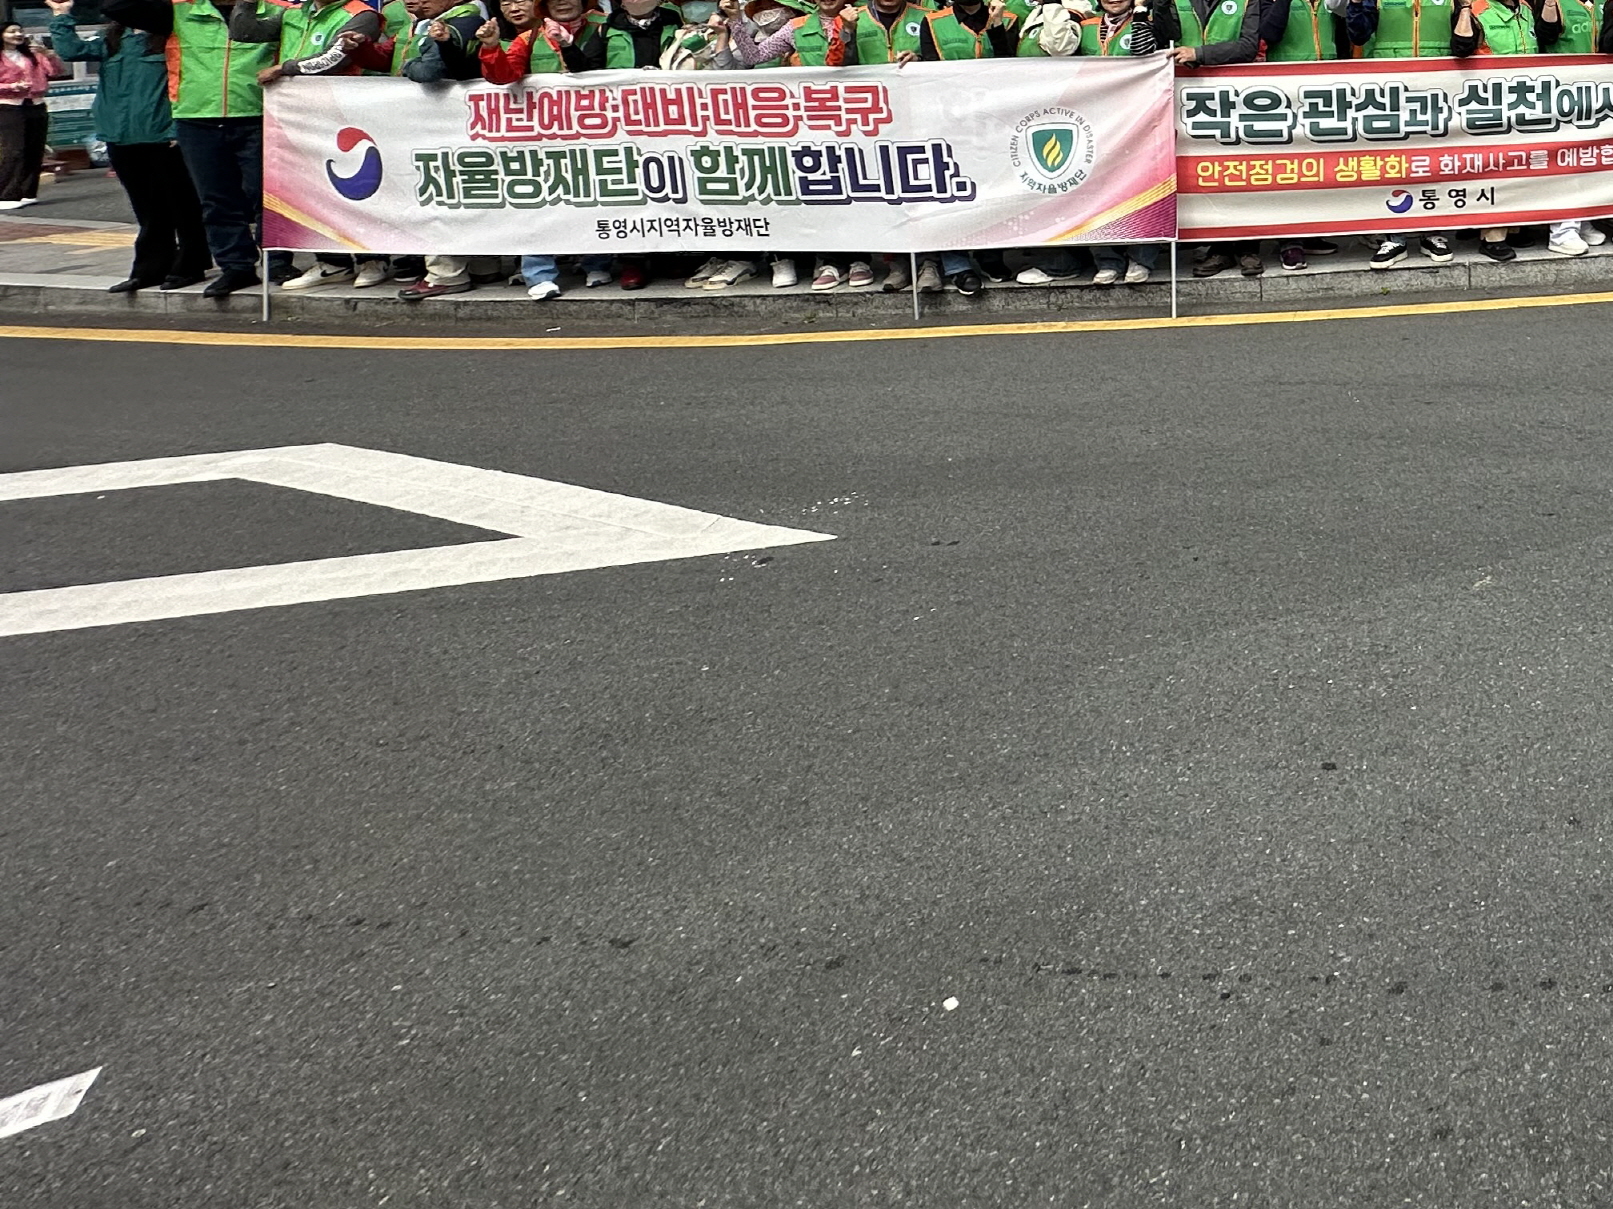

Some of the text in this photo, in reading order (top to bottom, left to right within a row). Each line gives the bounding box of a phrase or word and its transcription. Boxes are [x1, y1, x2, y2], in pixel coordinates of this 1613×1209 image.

[1182, 86, 1295, 144] 작은
[1298, 82, 1451, 140] 관심과
[1010, 135, 1021, 167] CITIZEN
[1016, 108, 1095, 165] CORPS ACTIVE IN DISASTER
[412, 144, 688, 208] 자율방재단이
[1020, 169, 1087, 194] 지역자율방재단
[1197, 158, 1324, 188] 안전점검의
[1334, 153, 1432, 182] 생활화로
[1438, 150, 1549, 177] 화재사고를
[1419, 186, 1496, 210] 통영시
[595, 216, 770, 239] 통영시지역자율방재단
